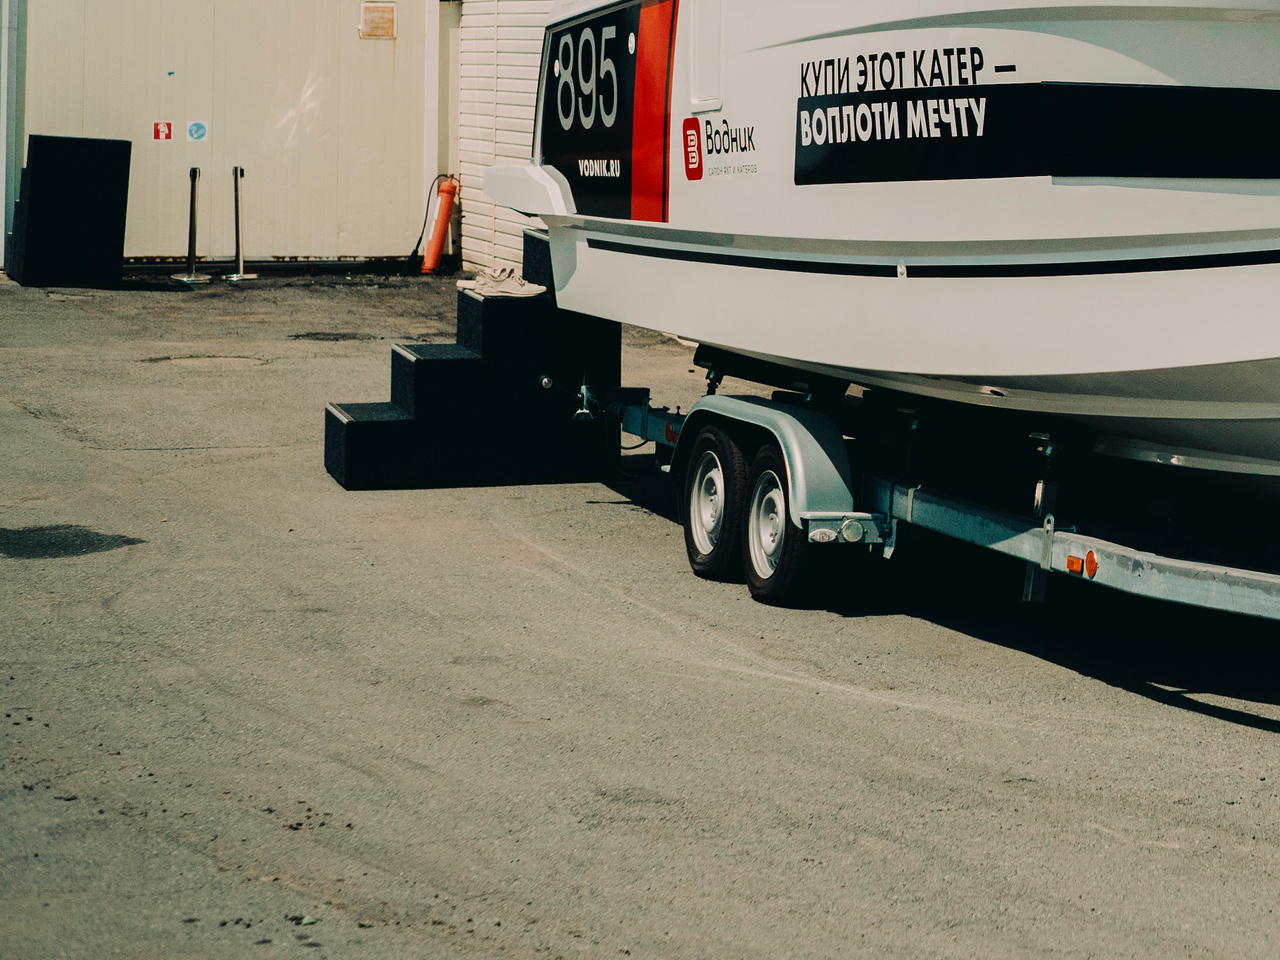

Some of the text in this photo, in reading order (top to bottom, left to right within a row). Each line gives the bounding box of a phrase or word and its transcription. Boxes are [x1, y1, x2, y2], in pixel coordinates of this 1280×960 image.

[557, 25, 618, 131] 895
[800, 57, 850, 98] КУПИ
[856, 51, 906, 92] ЭТОТ
[913, 46, 984, 88] КАТЕР
[705, 119, 756, 155] Водник
[800, 97, 987, 147] ВОПЛОТИ МЕЧТУ
[578, 159, 621, 178] VODNIK.RU
